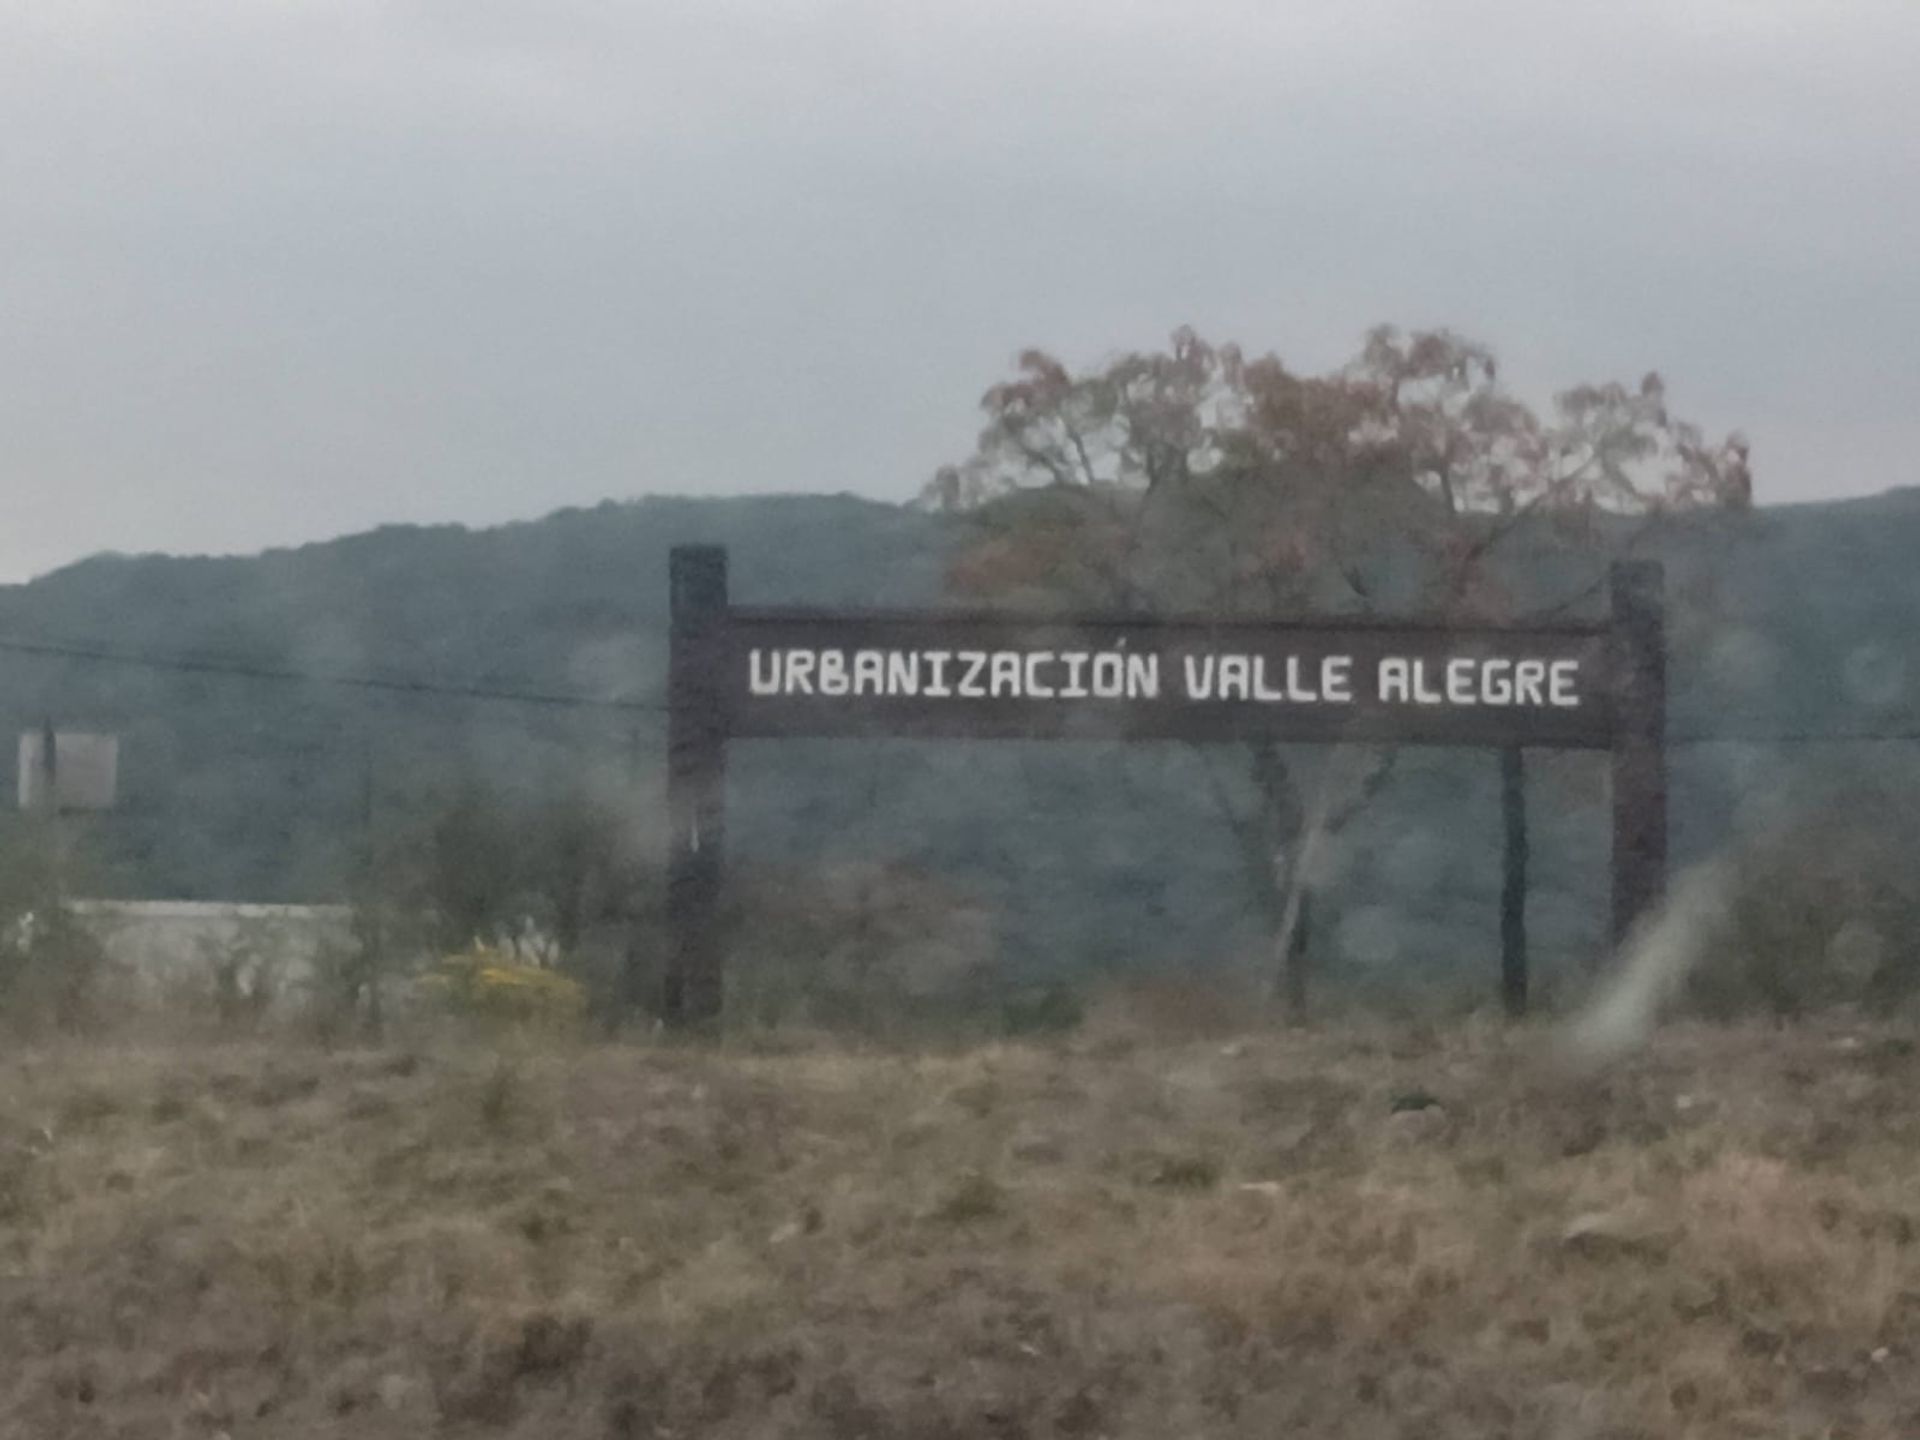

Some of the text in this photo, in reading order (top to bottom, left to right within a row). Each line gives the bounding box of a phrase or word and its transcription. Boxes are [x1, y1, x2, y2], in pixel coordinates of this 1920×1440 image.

[749, 637, 1580, 706] URBANIZACIÓN VALLE ALEGRE
